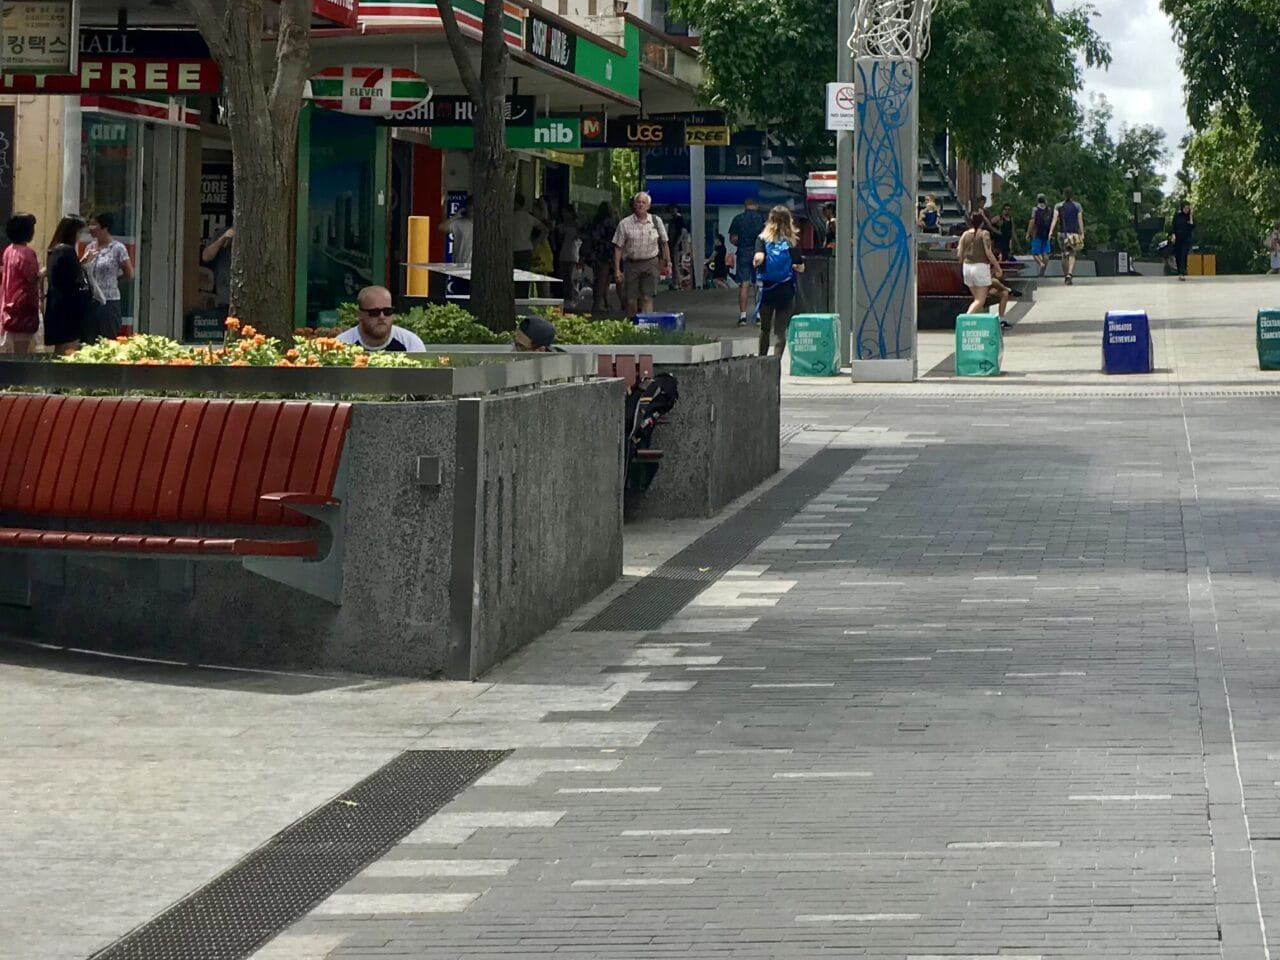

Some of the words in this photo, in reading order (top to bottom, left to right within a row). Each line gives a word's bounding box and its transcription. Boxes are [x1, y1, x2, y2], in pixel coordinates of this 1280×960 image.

[5, 35, 67, 55] 킹택스
[80, 62, 201, 90] FREE
[534, 123, 573, 143] nib
[735, 153, 752, 167] 141
